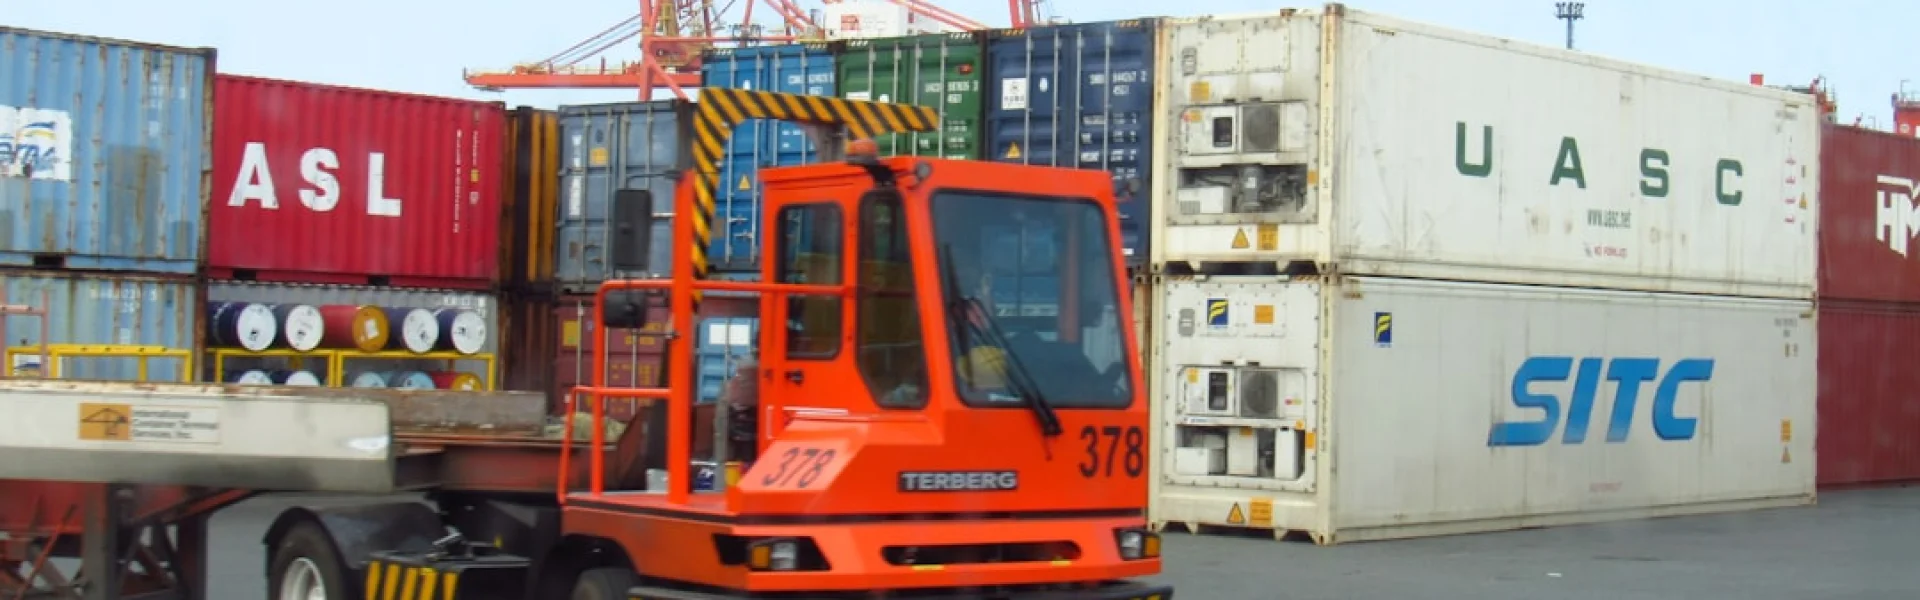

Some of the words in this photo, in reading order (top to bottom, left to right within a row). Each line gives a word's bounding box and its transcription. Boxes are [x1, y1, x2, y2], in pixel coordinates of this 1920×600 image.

[227, 141, 402, 217] ASL
[1455, 120, 1743, 206] UASC
[1486, 356, 1715, 446] SITC
[761, 446, 837, 488] 378
[901, 471, 1018, 491] TERBERG
[1079, 426, 1144, 479] 378
